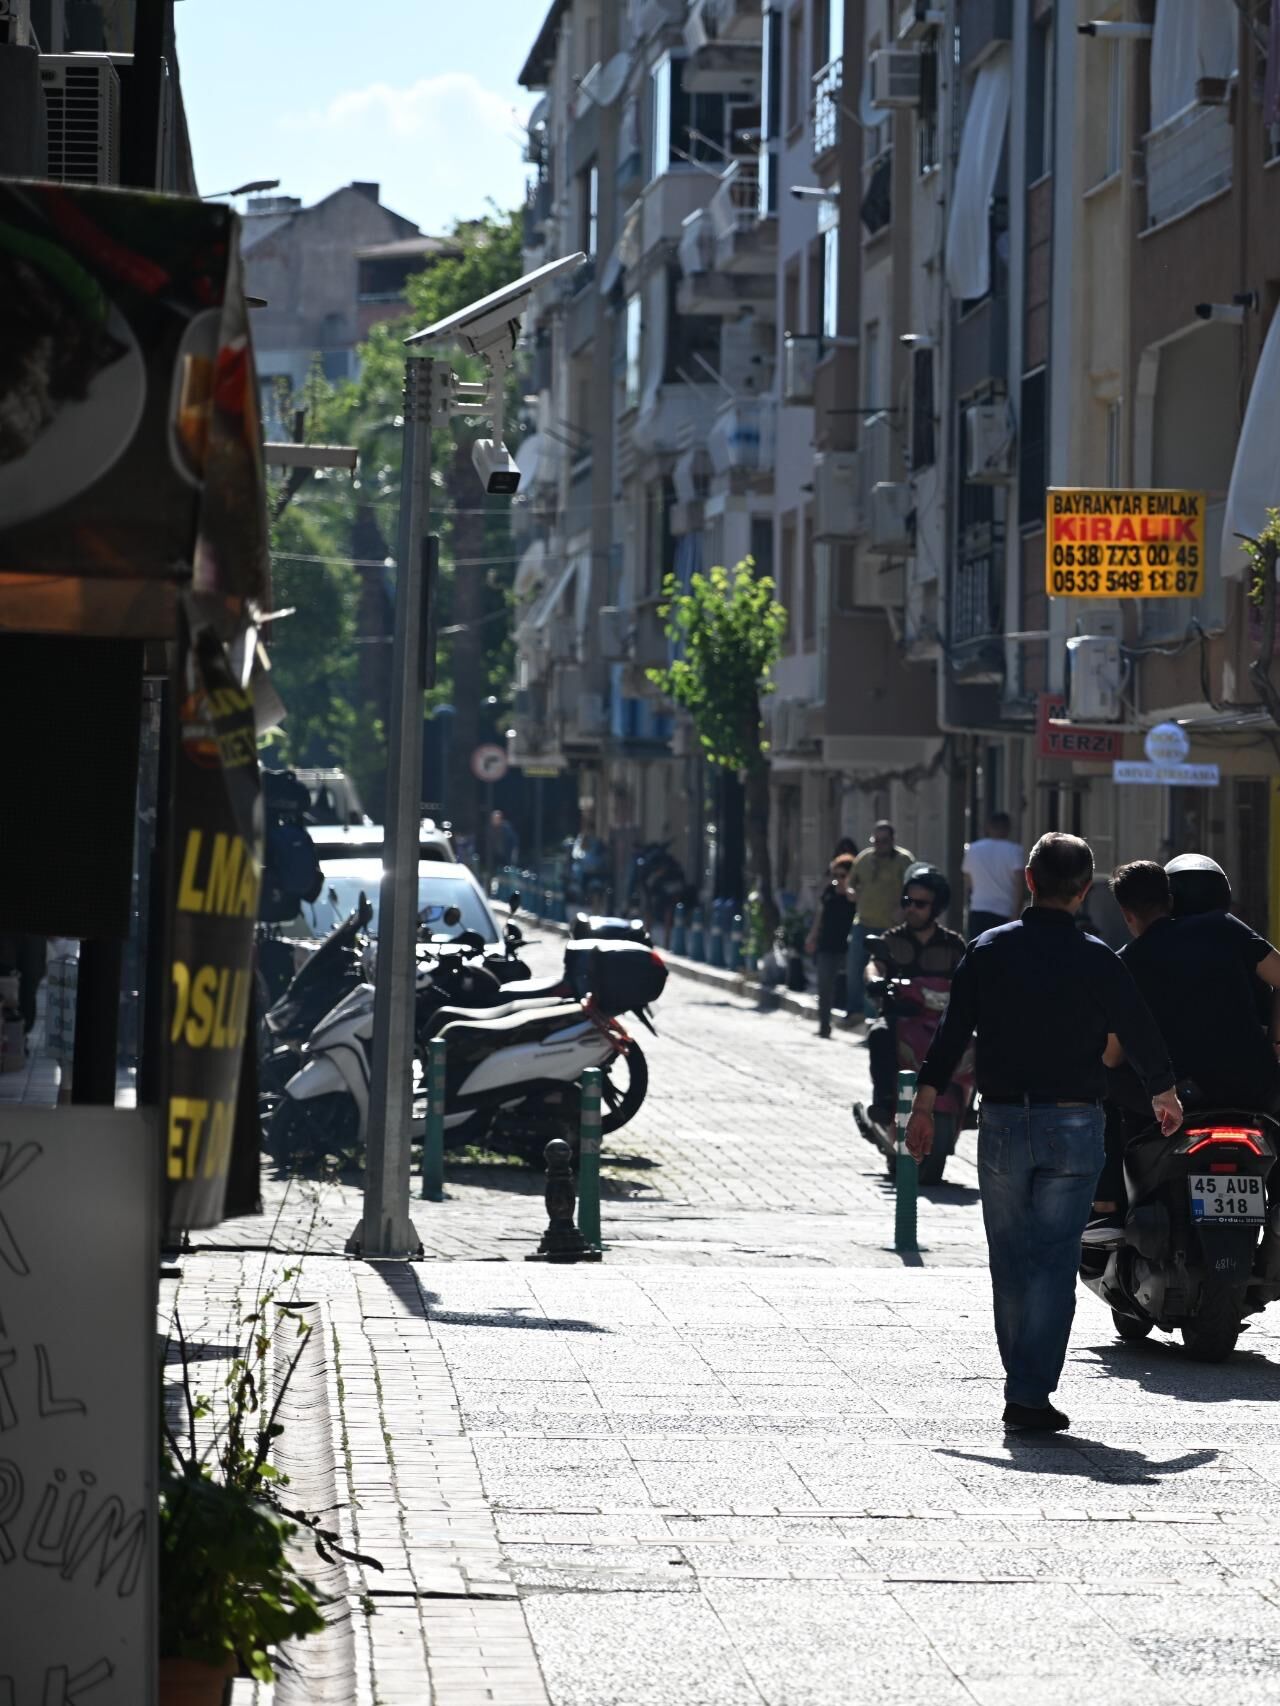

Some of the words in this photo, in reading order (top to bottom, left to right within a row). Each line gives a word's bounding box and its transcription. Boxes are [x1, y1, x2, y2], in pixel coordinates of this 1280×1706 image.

[1053, 495, 1142, 514] BAYRAKTAR
[1147, 496, 1199, 515] EMLAK
[1053, 545, 1099, 566] 0538
[1106, 545, 1141, 566] 773
[1147, 545, 1170, 566] 00
[1176, 545, 1199, 566] 45
[1053, 571, 1100, 592] 0533
[1106, 571, 1141, 592] 549
[1175, 571, 1199, 592] 87
[1195, 1178, 1216, 1194] 45
[1226, 1178, 1260, 1194] AUB
[1214, 1199, 1248, 1213] 318
